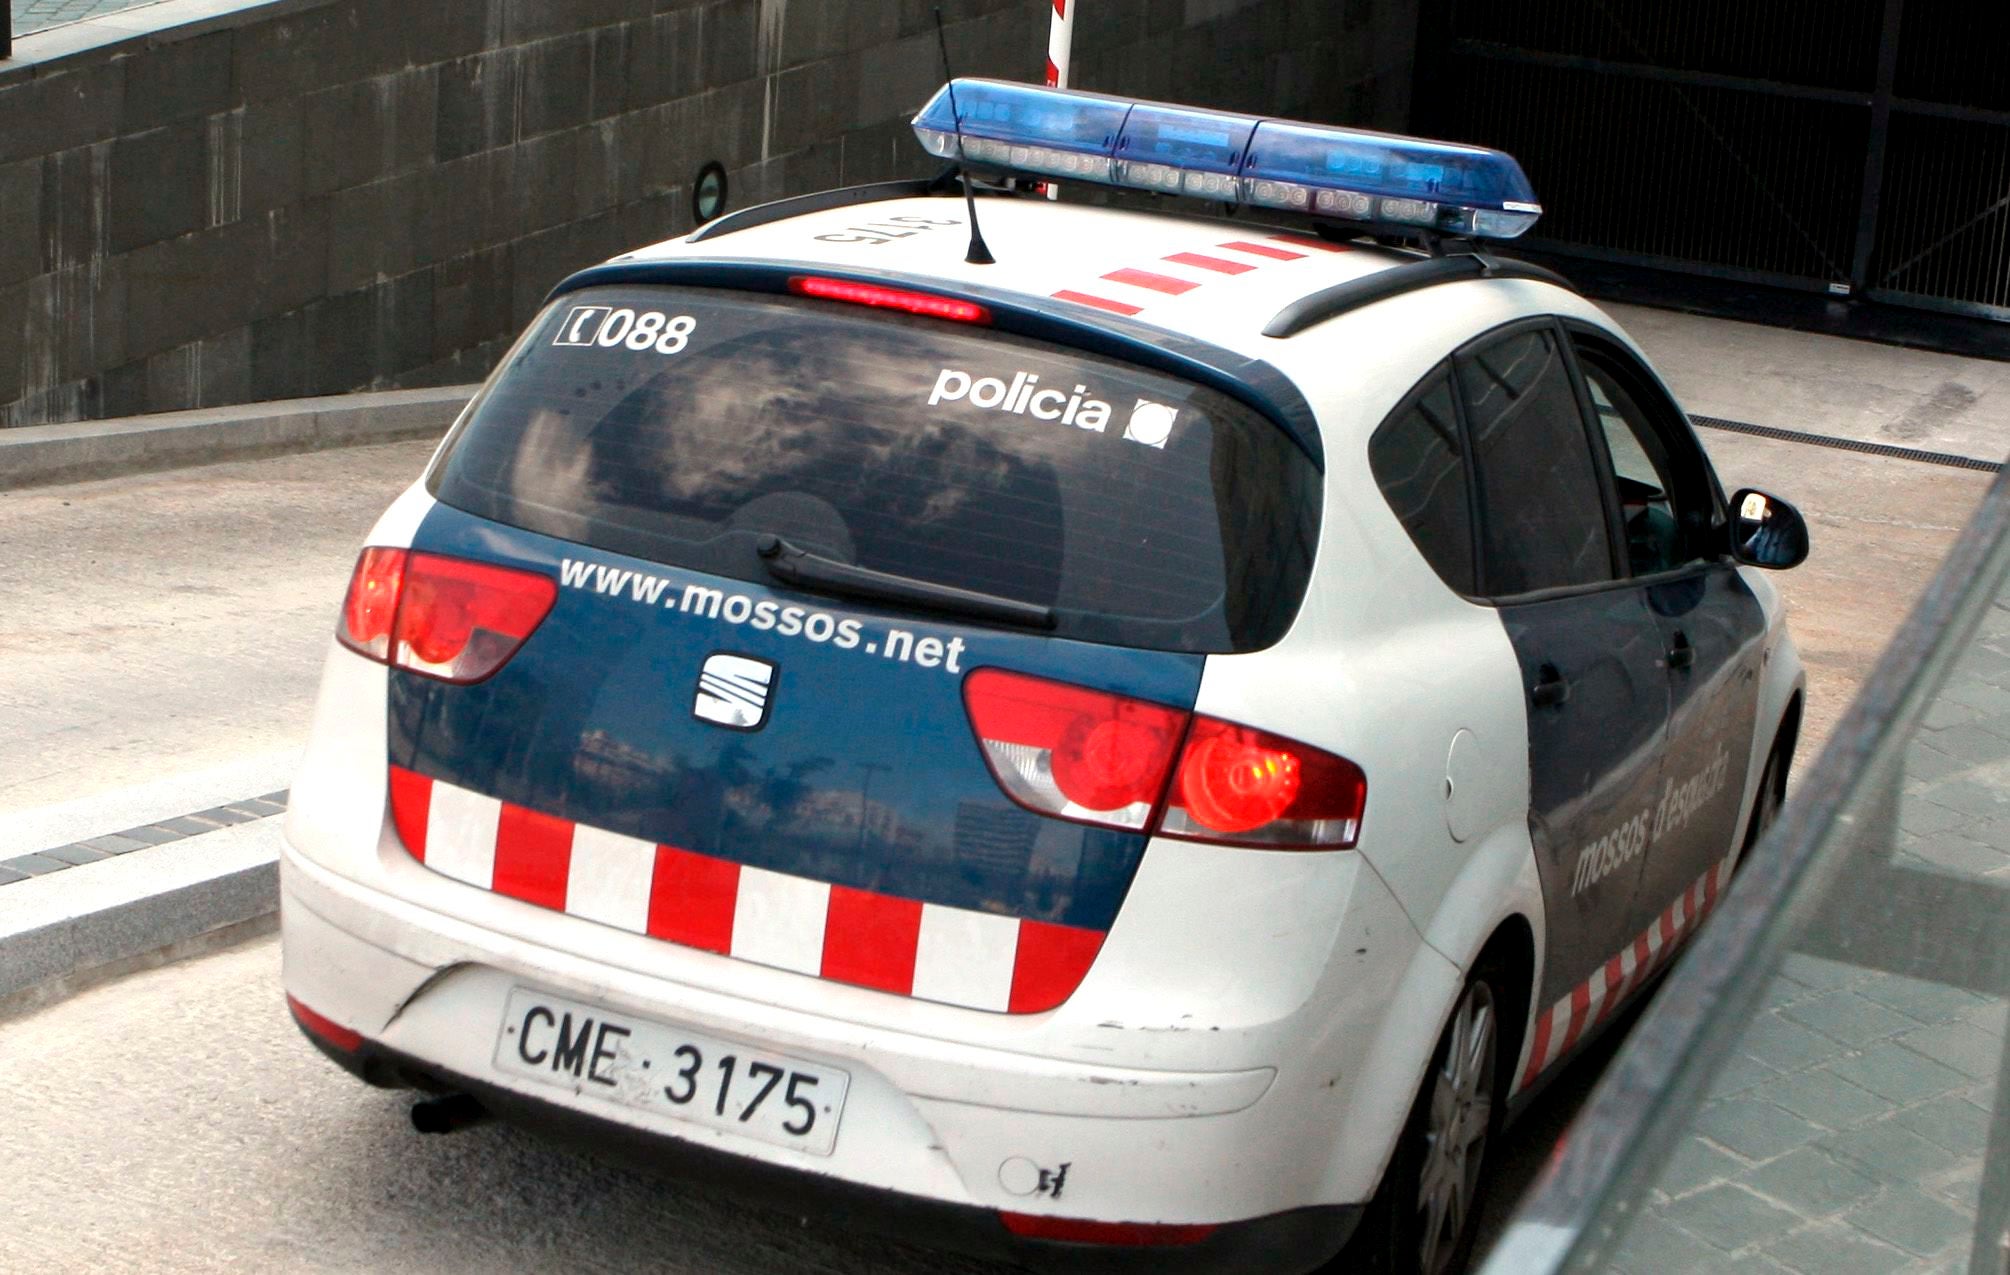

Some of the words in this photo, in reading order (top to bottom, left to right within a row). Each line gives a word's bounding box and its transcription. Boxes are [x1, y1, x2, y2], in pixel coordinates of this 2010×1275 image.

[598, 309, 697, 354] 088
[928, 369, 1111, 432] policia
[560, 558, 965, 674] www.mossos.net
[1571, 808, 1649, 897] mossos
[519, 1006, 631, 1086] CME
[664, 1045, 818, 1136] 3175
